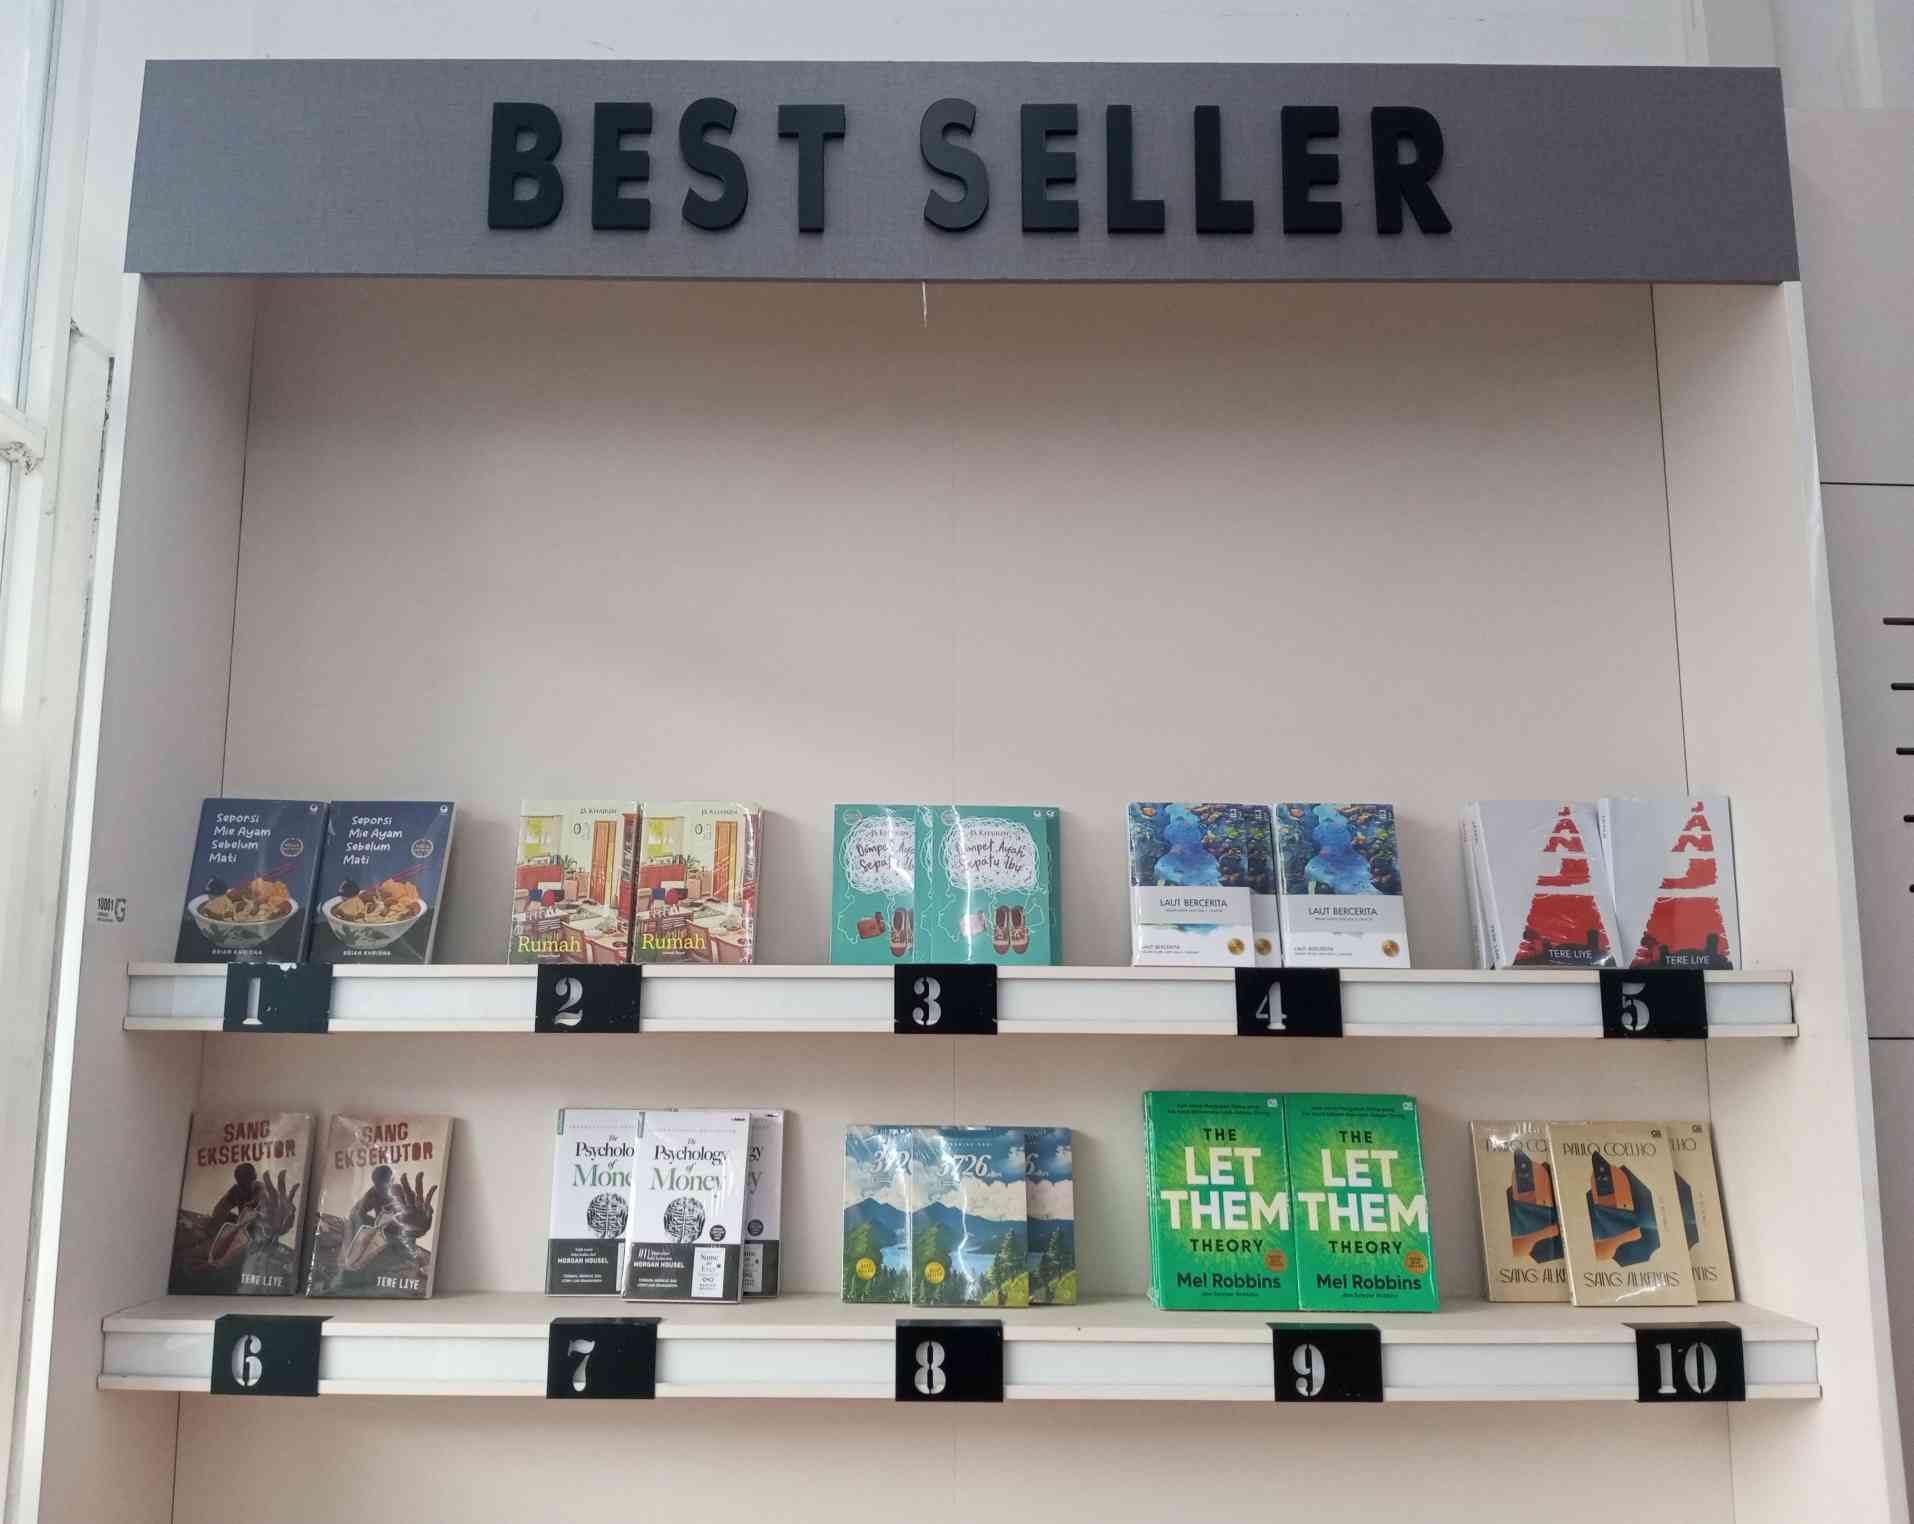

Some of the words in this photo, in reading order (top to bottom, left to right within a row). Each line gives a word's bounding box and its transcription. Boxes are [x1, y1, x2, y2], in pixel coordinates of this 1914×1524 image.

[488, 97, 846, 233] BEST
[919, 97, 1452, 234] SELLER
[216, 812, 260, 824] Seporsi
[351, 815, 393, 826] Seporsi
[213, 826, 235, 836] Mie
[237, 826, 271, 838] Ayam
[348, 828, 369, 839] Mie
[370, 828, 403, 840] Ayam
[211, 839, 259, 850] Sebelum
[345, 841, 391, 852] Sebelum
[208, 852, 238, 863] Mati
[343, 854, 370, 865] Mati
[1160, 898, 1181, 907] LAUT
[1184, 898, 1229, 908] BERCERITA
[1308, 907, 1331, 915] LAUT
[1333, 907, 1378, 916] BERCERITA
[517, 935, 581, 953] Rumah
[642, 932, 706, 950] Rumah
[1549, 949, 1572, 959] TERE
[1574, 949, 1593, 960] LIYE
[1665, 955, 1688, 965] TERE
[1690, 955, 1711, 965] LIYE
[242, 976, 263, 1025] 1
[553, 977, 583, 1026] 2
[912, 977, 941, 1026] 3
[1255, 981, 1288, 1030] 4
[1621, 982, 1650, 1031] 5
[223, 1119, 271, 1143] SANG
[362, 1122, 409, 1145] SANG
[1203, 1128, 1237, 1141] THE
[1338, 1130, 1373, 1143] THE
[197, 1138, 296, 1168] EKSEKUTOR
[334, 1141, 433, 1169] EKSEKUTOR
[575, 1141, 635, 1160] Psycholo
[654, 1144, 728, 1167] Psychology
[1562, 1142, 1601, 1156] PAULO
[1602, 1142, 1657, 1157] COELHO
[1184, 1146, 1262, 1186] LET
[1320, 1148, 1399, 1188] LET
[649, 1167, 722, 1198] Money
[1160, 1190, 1290, 1231] THEM
[1297, 1192, 1429, 1233] THEM
[1190, 1239, 1264, 1253] THEORY
[1328, 1240, 1402, 1255] THEORY
[241, 1273, 262, 1285] TERE
[262, 1274, 284, 1288] LIYE
[376, 1276, 398, 1288] TERE
[398, 1278, 420, 1290] LIYE
[1176, 1272, 1207, 1288] Mel
[1212, 1272, 1281, 1289] Robbins
[1316, 1273, 1347, 1289] Mel
[1352, 1274, 1422, 1290] Robbins
[1498, 1268, 1538, 1284] SANG
[1583, 1271, 1624, 1288] SANG
[231, 1334, 263, 1387] 6
[568, 1338, 596, 1392] 7
[914, 1340, 946, 1395] 8
[1656, 1342, 1717, 1394] 10
[1291, 1343, 1326, 1397] 9
